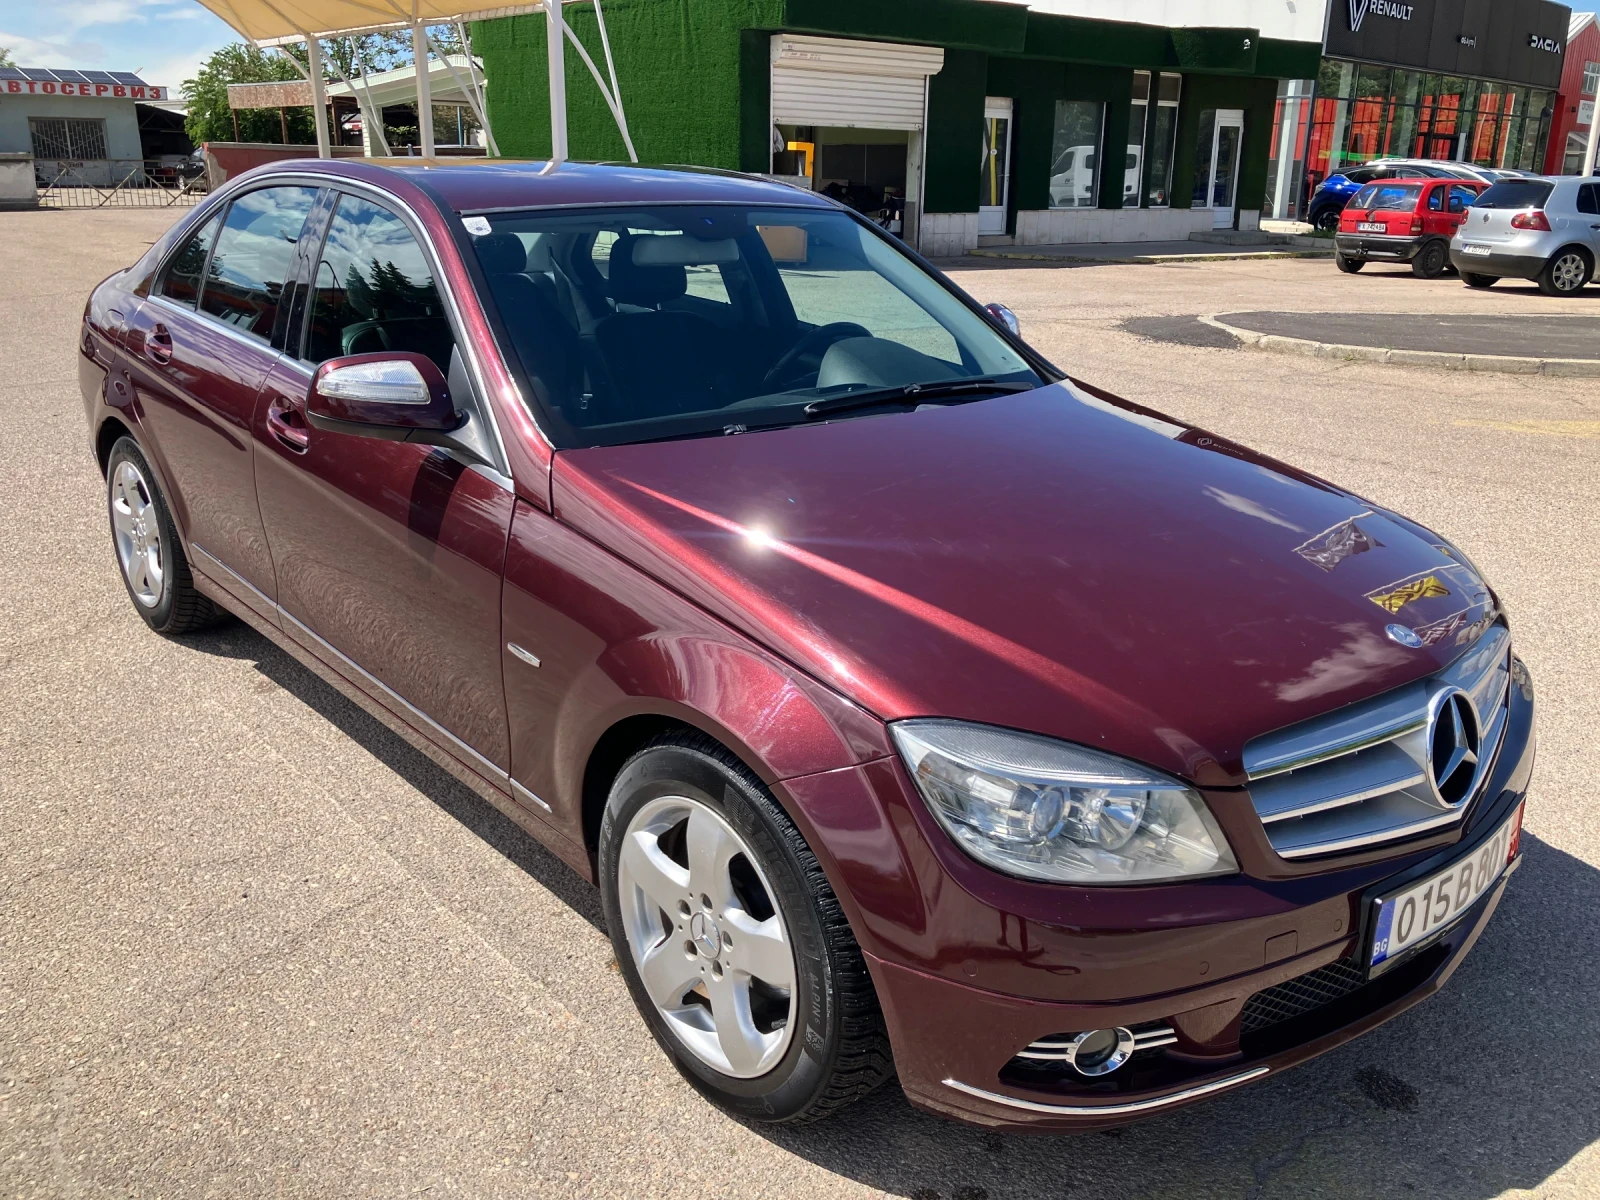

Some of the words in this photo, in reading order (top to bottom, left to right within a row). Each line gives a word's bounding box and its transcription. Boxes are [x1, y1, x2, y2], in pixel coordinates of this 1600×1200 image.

[1370, 0, 1413, 20] RENAULT
[1532, 35, 1561, 54] DACIA
[0, 80, 161, 99] ВТОСЕРВИЗ
[1374, 938, 1388, 956] BG
[808, 971, 821, 1018] ALPIN
